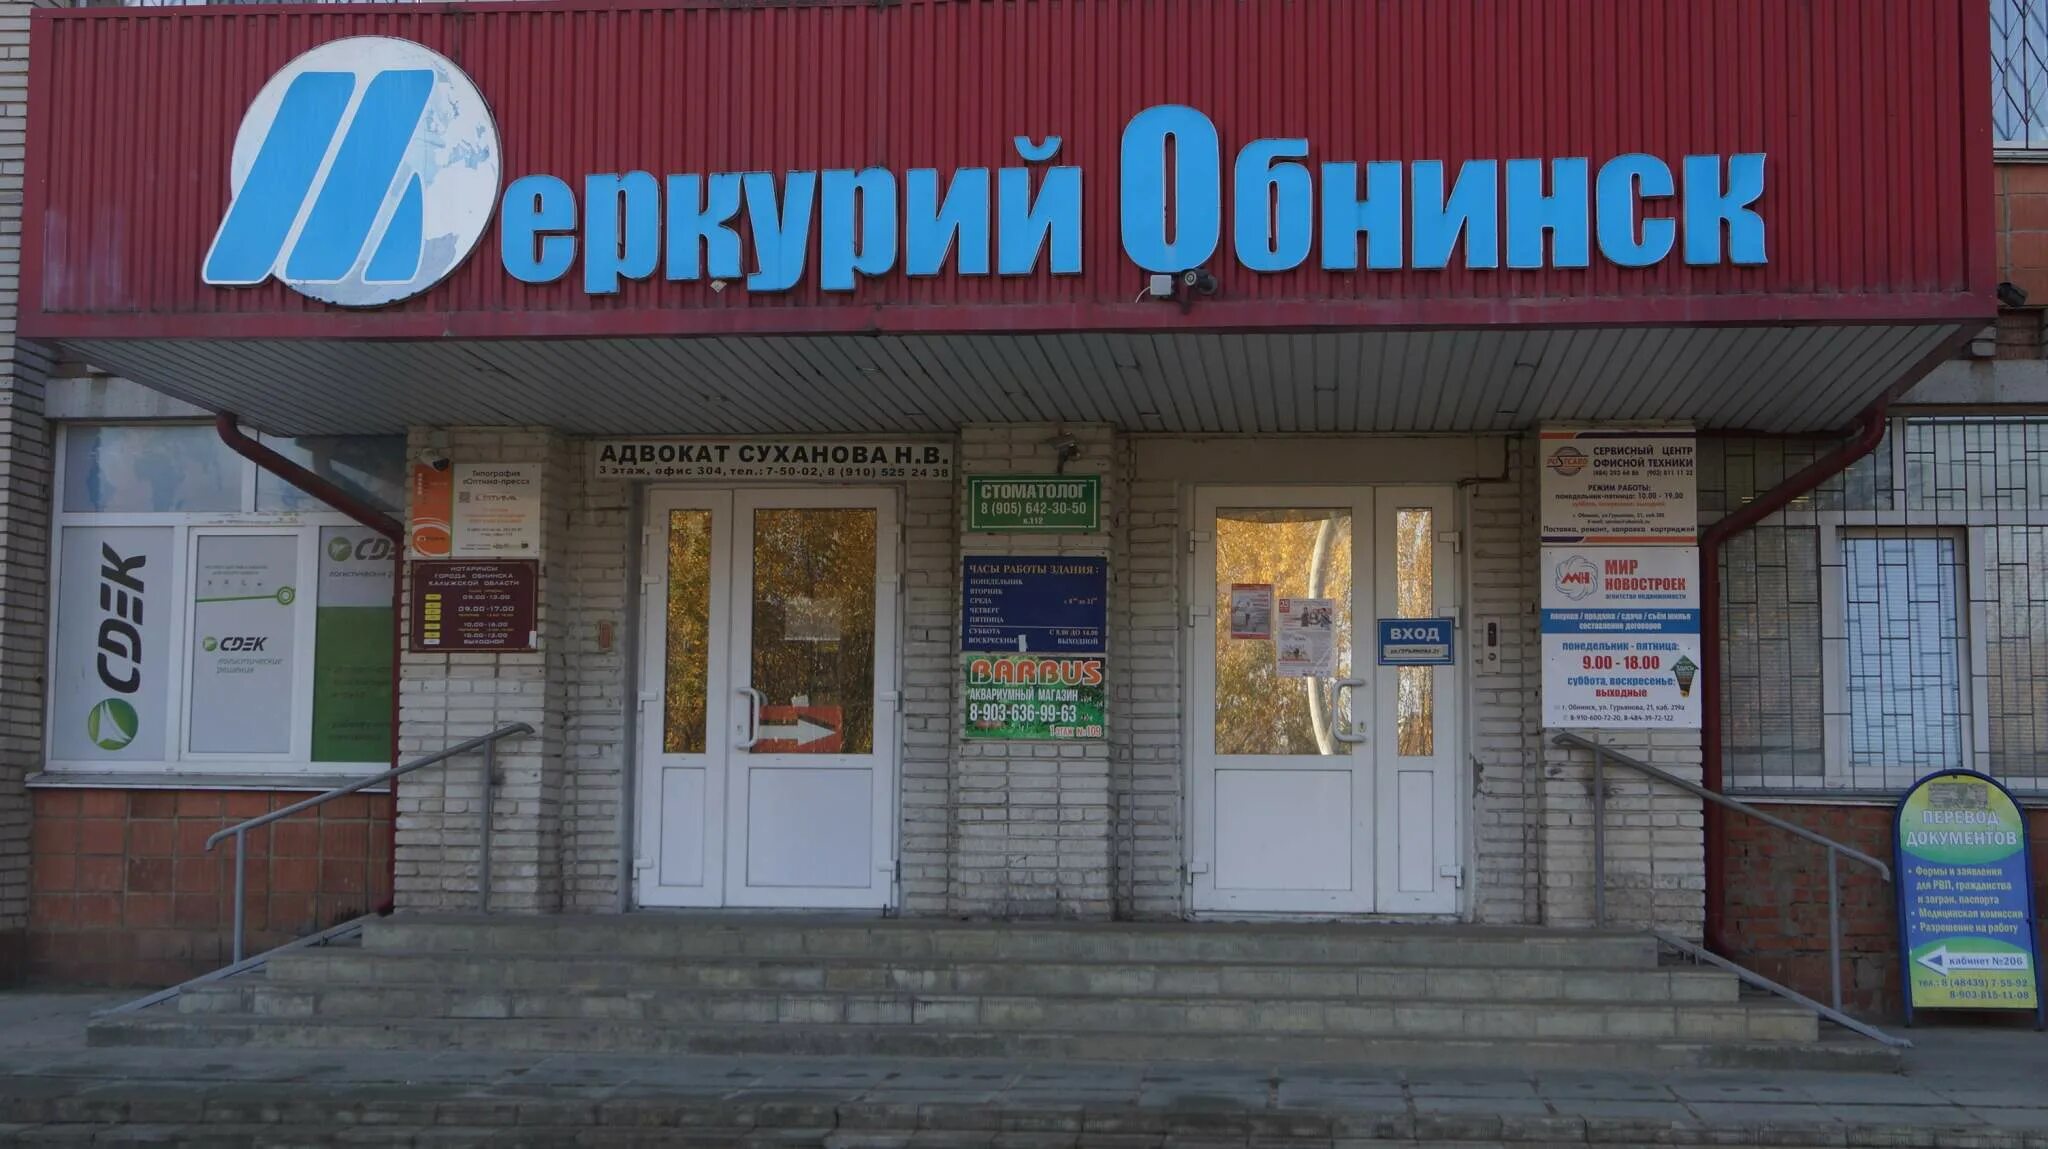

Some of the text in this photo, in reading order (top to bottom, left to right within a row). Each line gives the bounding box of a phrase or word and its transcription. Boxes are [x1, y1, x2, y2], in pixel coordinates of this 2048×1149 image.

[1121, 103, 1769, 274] Обнинск
[600, 445, 949, 465] АДВОКАТ СУХАНОВА Н.В.
[1593, 445, 1693, 456] СЕРВИСНЫЙ ЦЕНТР
[1593, 457, 1693, 468] ОФИСНОЙ ТЕХНИКИ
[599, 466, 949, 478] 3 этаж, офис 304, тел.: 7-50-02, 8 (910) 525 24 38
[981, 484, 1087, 499] СТОМАТОЛОГ
[1618, 484, 1651, 492] РАБОТЫ:
[981, 502, 1086, 516] 8 (905) 642-30-50
[969, 564, 1000, 574] ЧАСЫ
[1003, 564, 1047, 574] РАБОТЫ
[1605, 559, 1639, 575] МИР
[1605, 577, 1686, 591] НОВОСТРОЕК
[1390, 627, 1440, 642] ВХОД
[1562, 642, 1629, 651] понедельник
[1636, 642, 1680, 652] пятница:
[1582, 655, 1612, 670] 9.00
[1623, 655, 1660, 670] 18.00
[970, 658, 1103, 686] BARBUS
[1567, 675, 1609, 687] суббота,
[1609, 676, 1676, 687] воскресенье:
[969, 687, 1079, 702] АКВАРИУМНЫЙ МАГАЗИН
[1595, 689, 1648, 698] выходные
[970, 703, 1077, 722] 8-903-636-99-63
[1568, 704, 1597, 712] Обнинск,
[1923, 810, 2000, 825] ПЕРЕВОД
[1906, 831, 2017, 847] ДОКУМЕНТОВ
[1916, 866, 1947, 877] Формы
[1933, 880, 1954, 891] РВП,
[1959, 896, 2000, 905] паспорта
[1988, 923, 2018, 934] работу
[1949, 956, 2023, 966] кабинет №206
